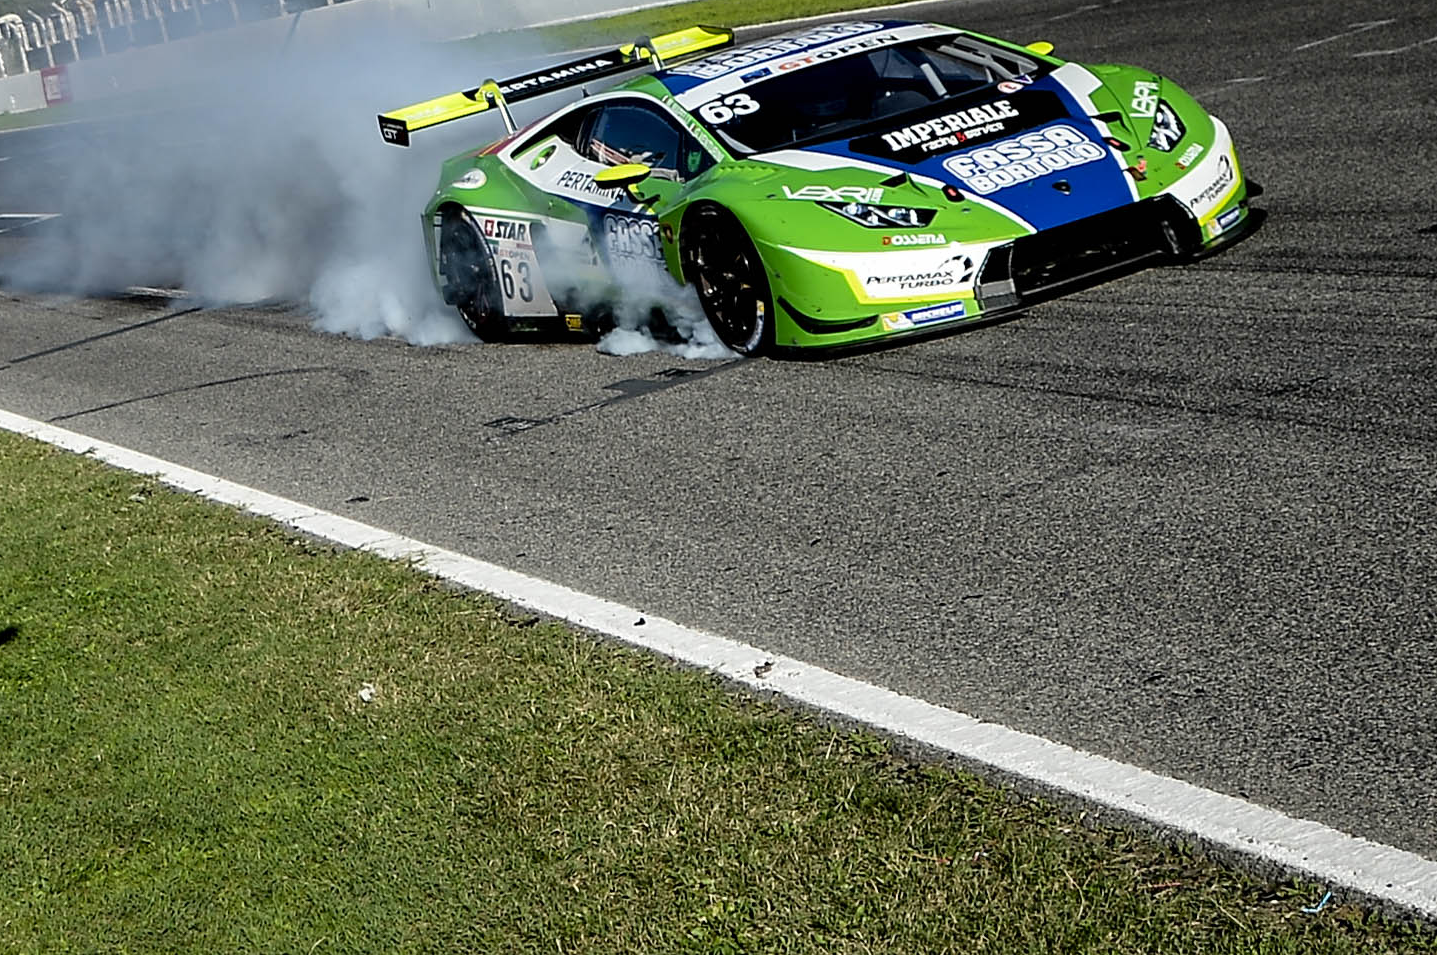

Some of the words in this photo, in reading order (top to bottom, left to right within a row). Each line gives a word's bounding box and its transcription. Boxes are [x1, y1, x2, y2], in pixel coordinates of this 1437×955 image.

[698, 93, 761, 125] 63
[881, 99, 1020, 152] IMPERIALE
[944, 125, 1090, 181] FASSA
[967, 141, 1106, 194] BORTOLO
[494, 219, 527, 242] STAR
[500, 258, 534, 303] 63
[866, 271, 954, 286] PERTAMAX
[899, 278, 955, 290] TURBO
